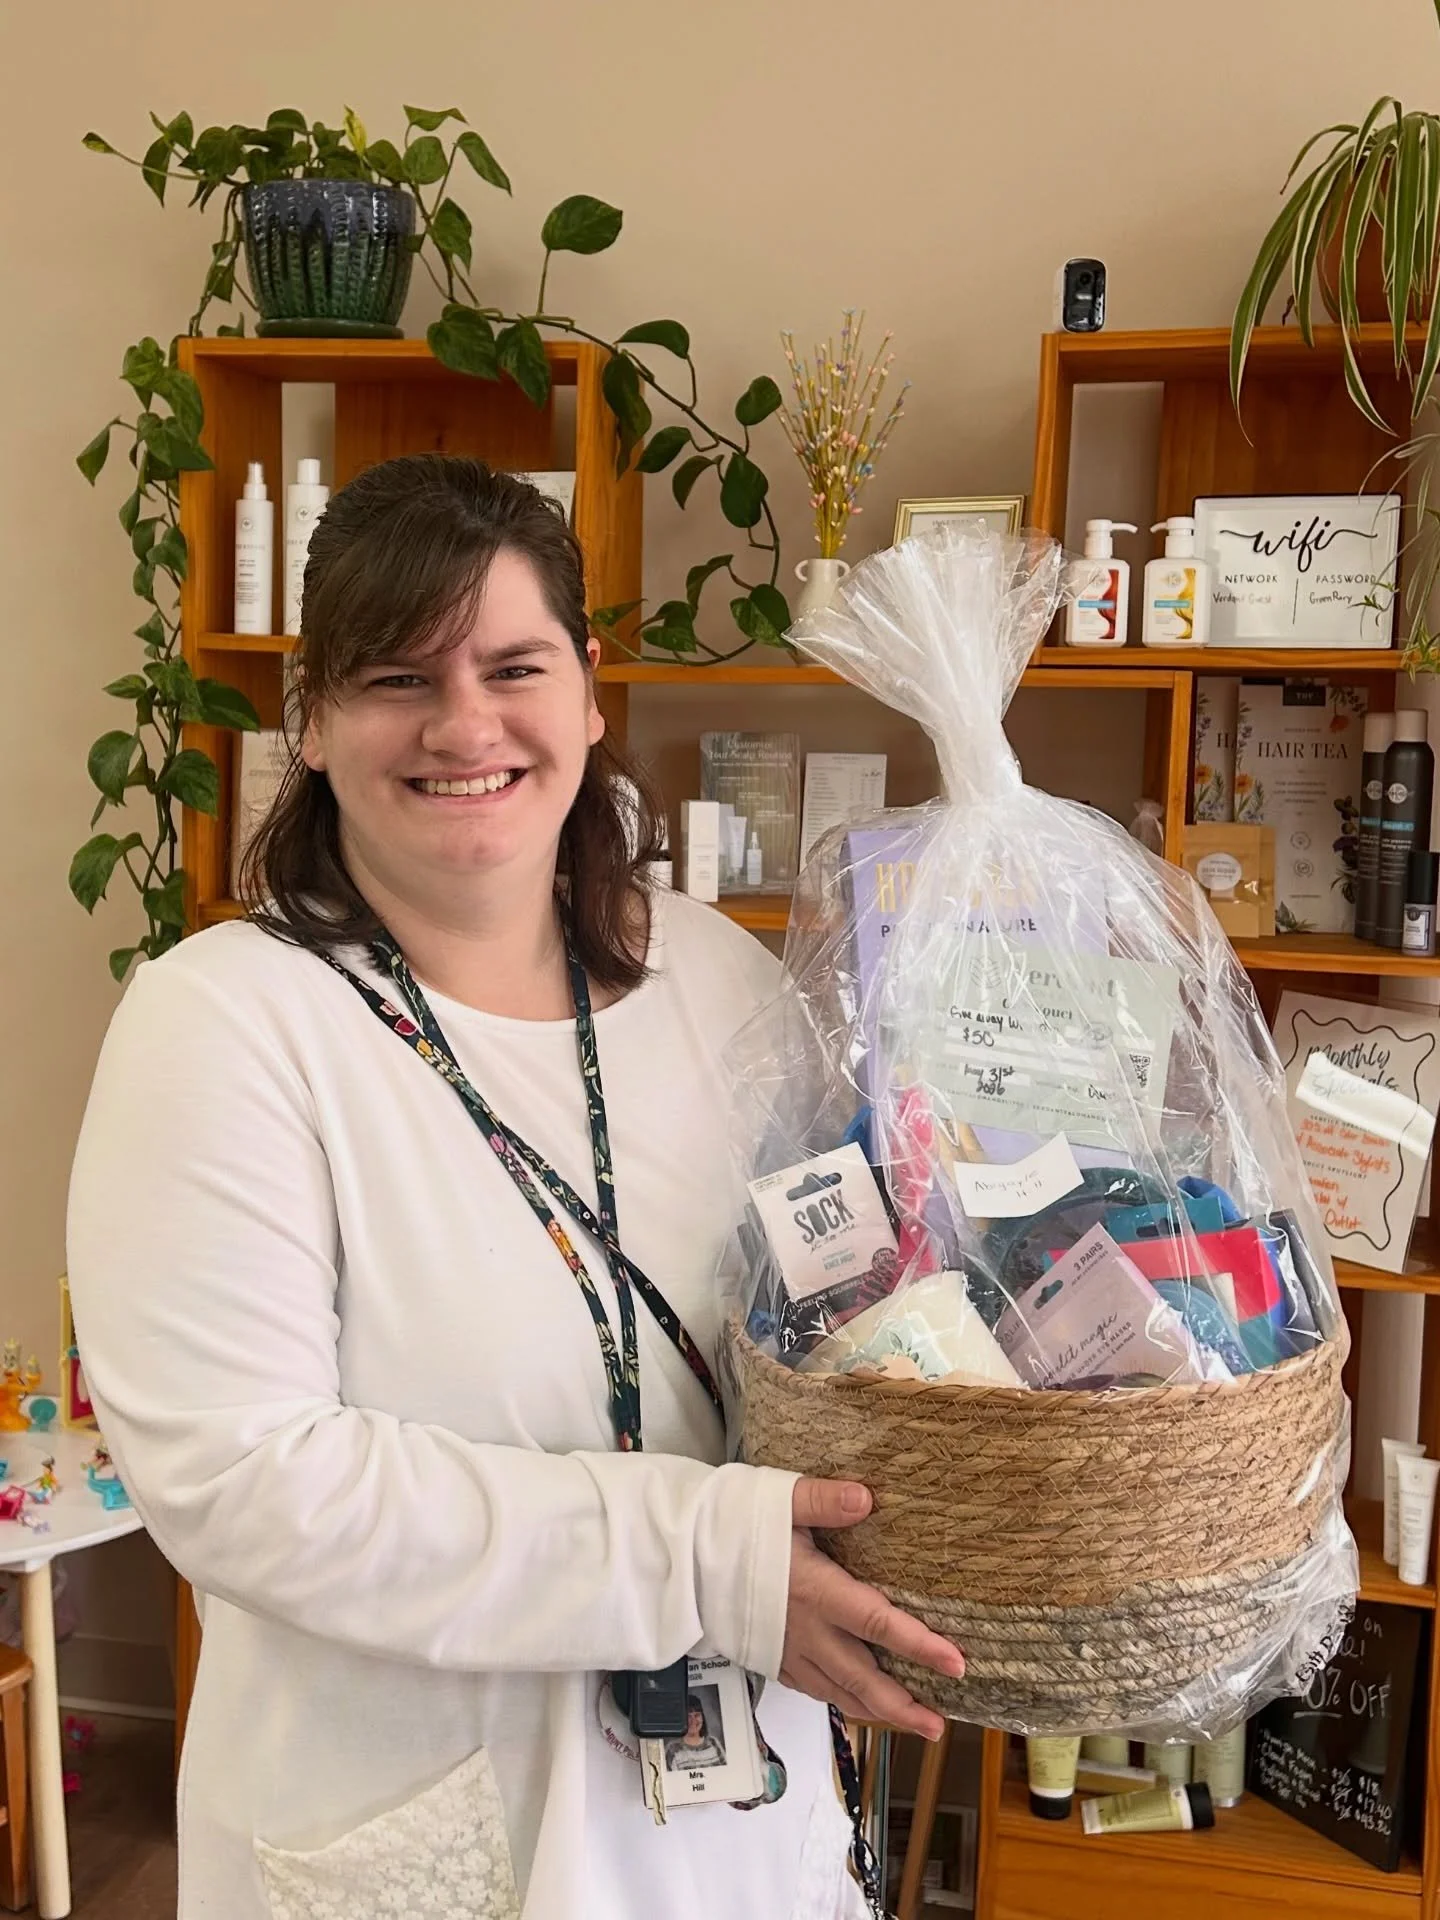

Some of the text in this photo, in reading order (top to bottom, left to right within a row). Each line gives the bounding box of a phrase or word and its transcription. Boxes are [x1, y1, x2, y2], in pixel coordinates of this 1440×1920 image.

[1224, 574, 1279, 584] NETWORK
[1316, 574, 1376, 585] PASSWORD
[1257, 742, 1348, 759] HAIR TEA
[963, 1027, 995, 1047] $50
[1304, 1042, 1391, 1069] Monthly
[794, 1188, 854, 1244] SOCK
[1073, 1261, 1081, 1271] 3
[1079, 1241, 1104, 1266] PAIRS
[701, 1660, 731, 1671] School
[1350, 1679, 1391, 1718] OFF
[692, 1784, 706, 1792] Hill
